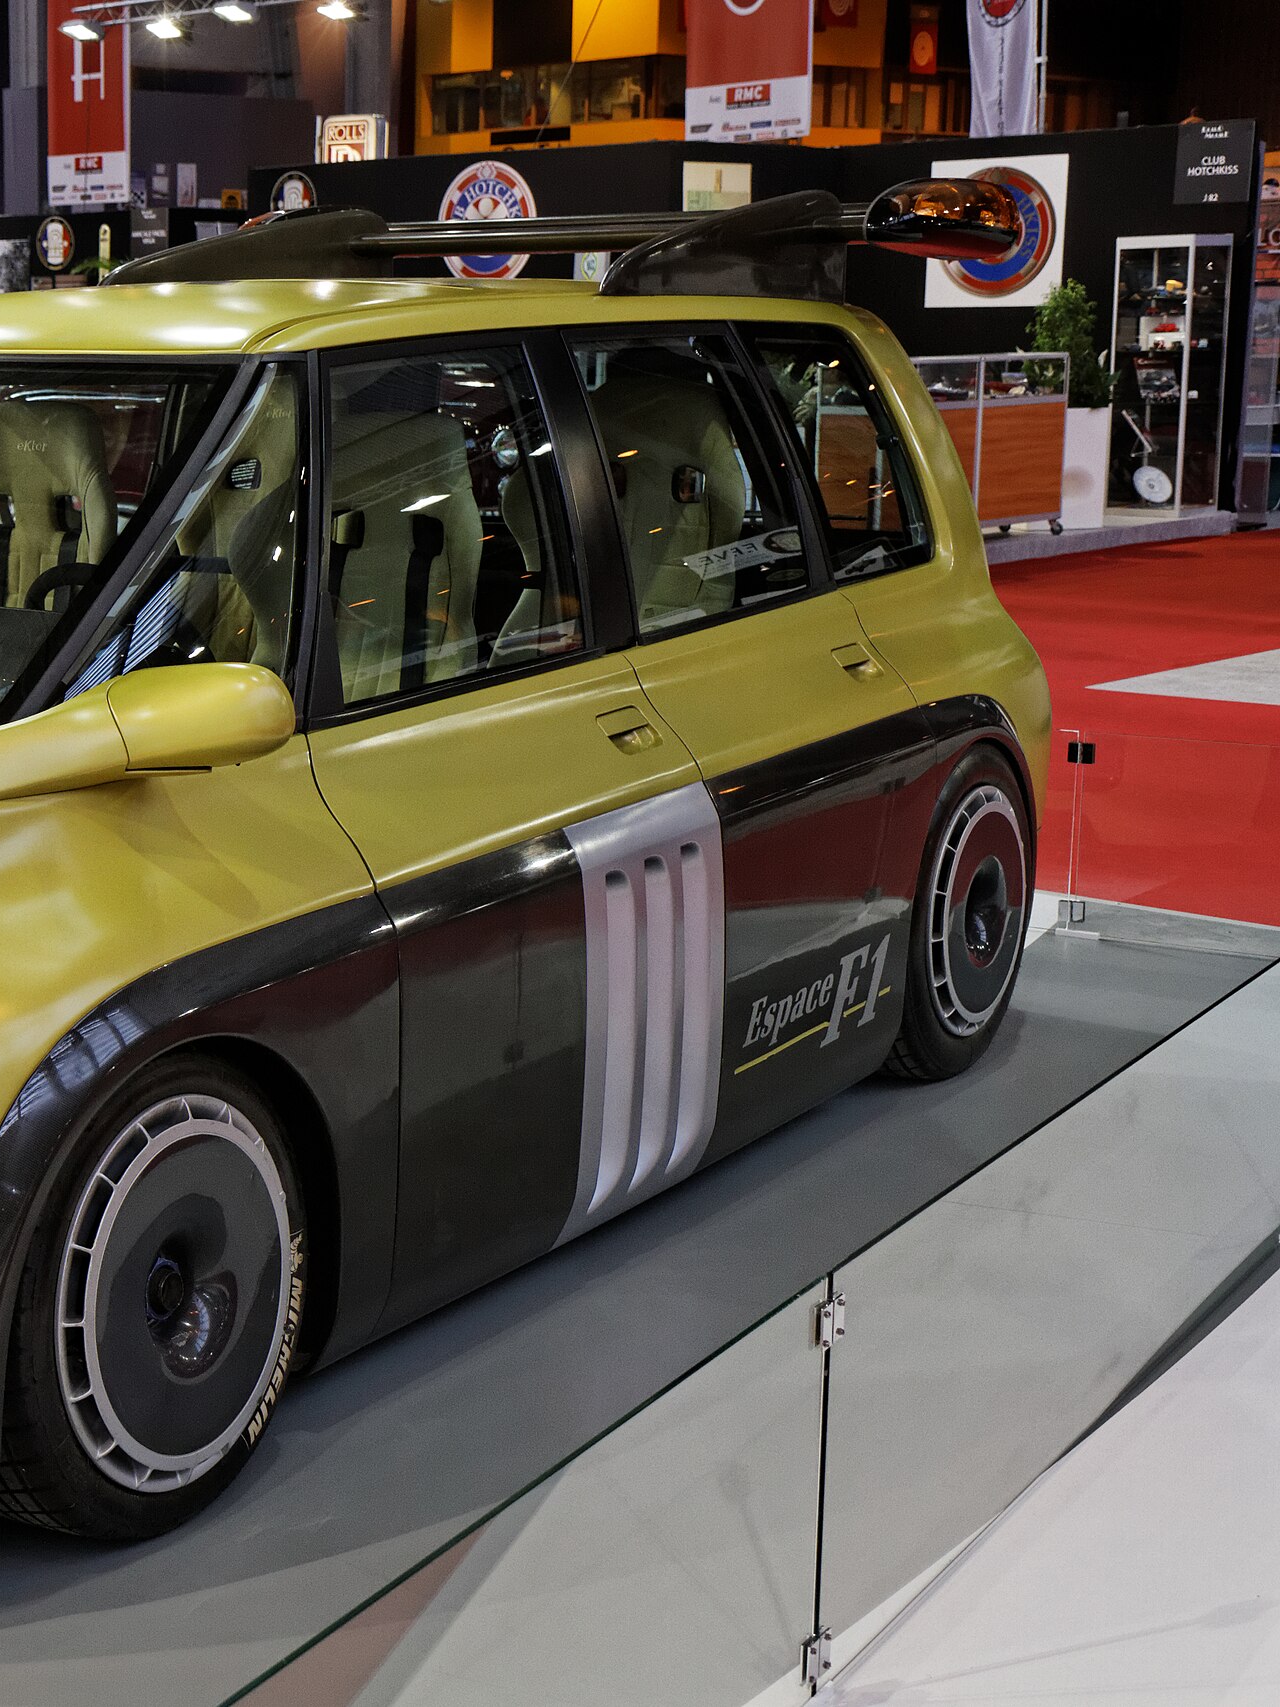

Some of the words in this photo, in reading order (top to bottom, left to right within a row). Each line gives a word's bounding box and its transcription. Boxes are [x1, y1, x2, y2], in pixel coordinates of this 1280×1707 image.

[71, 39, 105, 102] H
[734, 86, 764, 102] RMC
[328, 125, 365, 141] ROLLS
[1201, 156, 1226, 166] CLUB
[1187, 165, 1239, 177] HOTCHKISS
[464, 180, 521, 219] HOTCHK
[742, 973, 835, 1049] Espace
[820, 933, 891, 1049] F1
